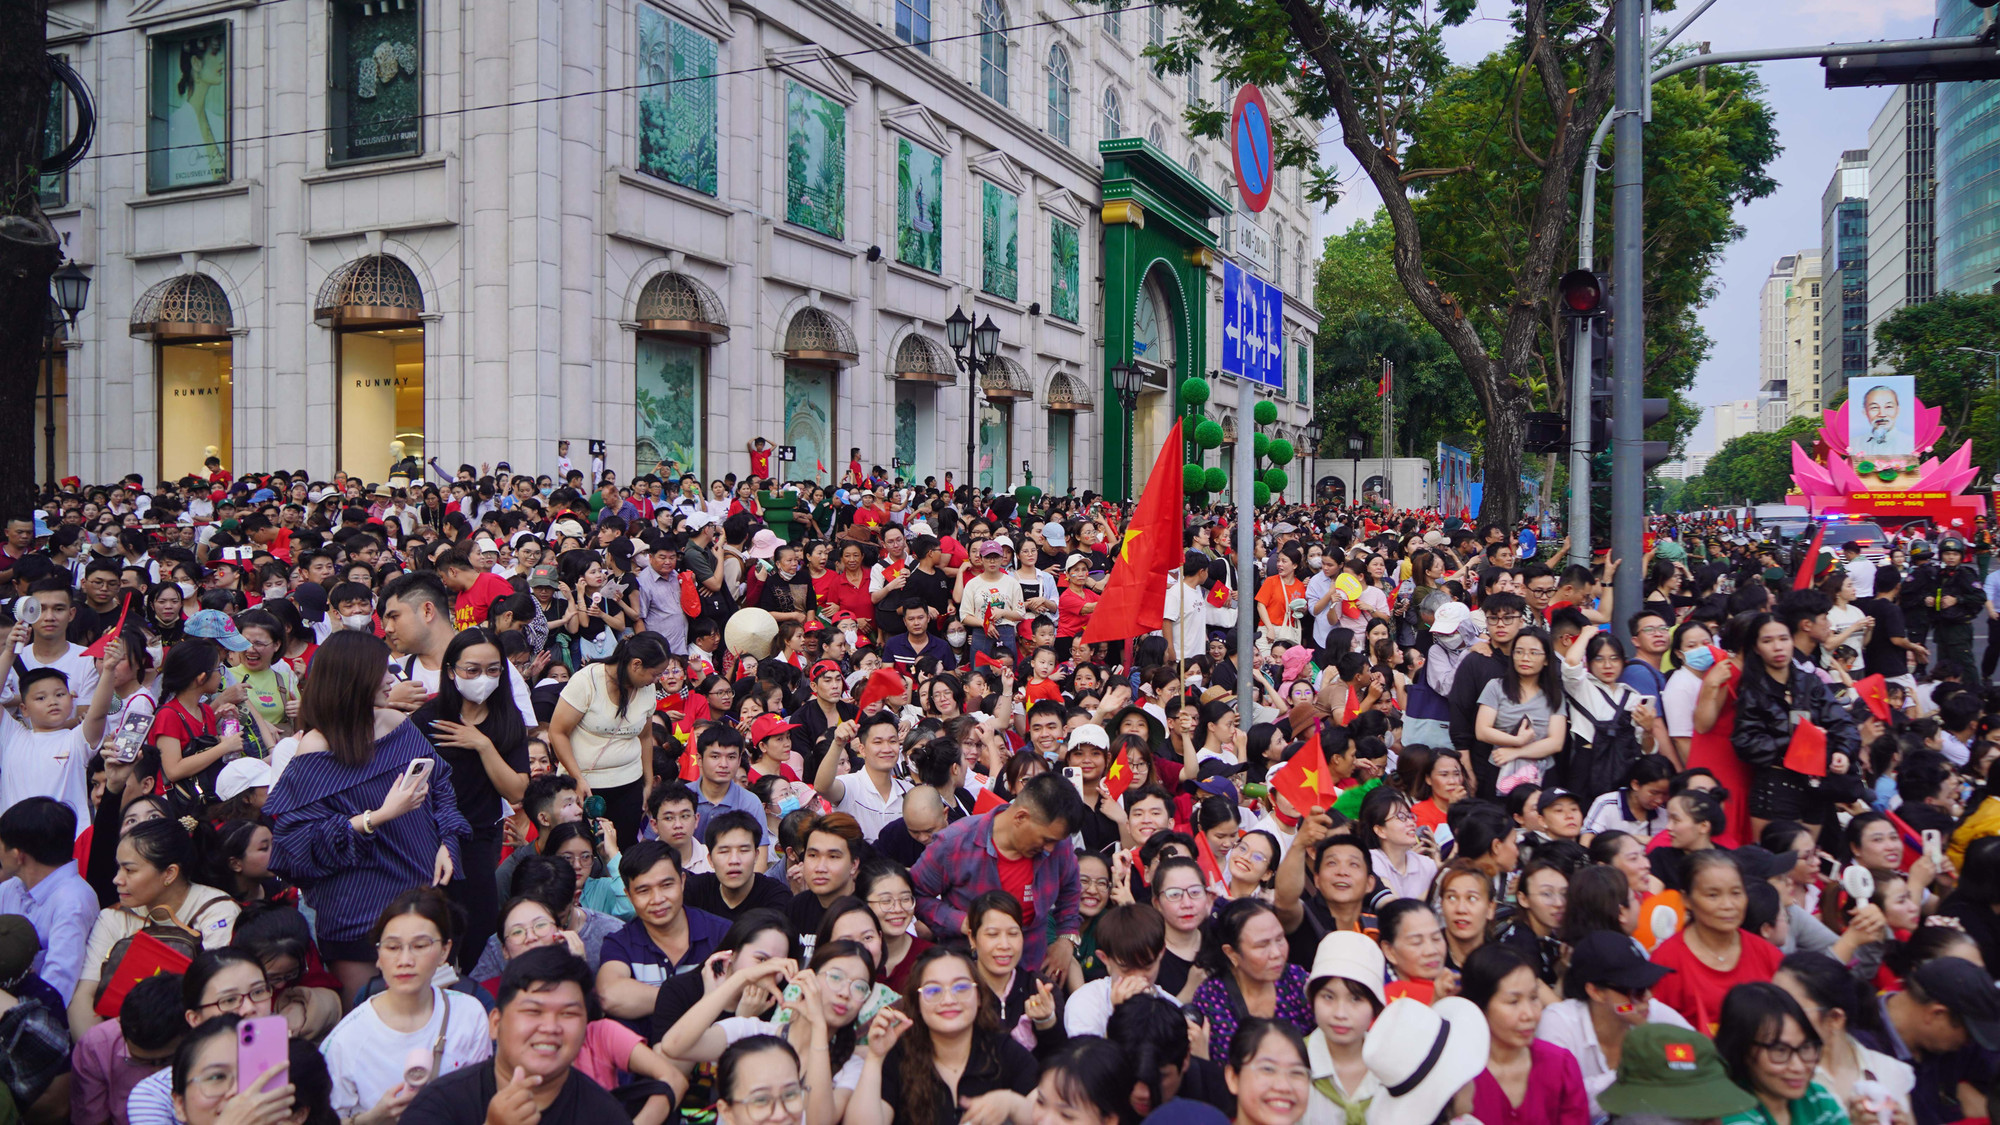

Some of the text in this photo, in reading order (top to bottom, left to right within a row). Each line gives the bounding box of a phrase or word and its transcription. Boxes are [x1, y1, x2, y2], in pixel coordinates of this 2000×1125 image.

[355, 135, 391, 147] EXCLUSIVELY
[392, 133, 400, 141] AT
[175, 169, 207, 180] EXCLUSIVELY
[207, 168, 214, 176] AT
[356, 377, 408, 388] RUNWAY
[174, 387, 219, 397] RUNWAY
